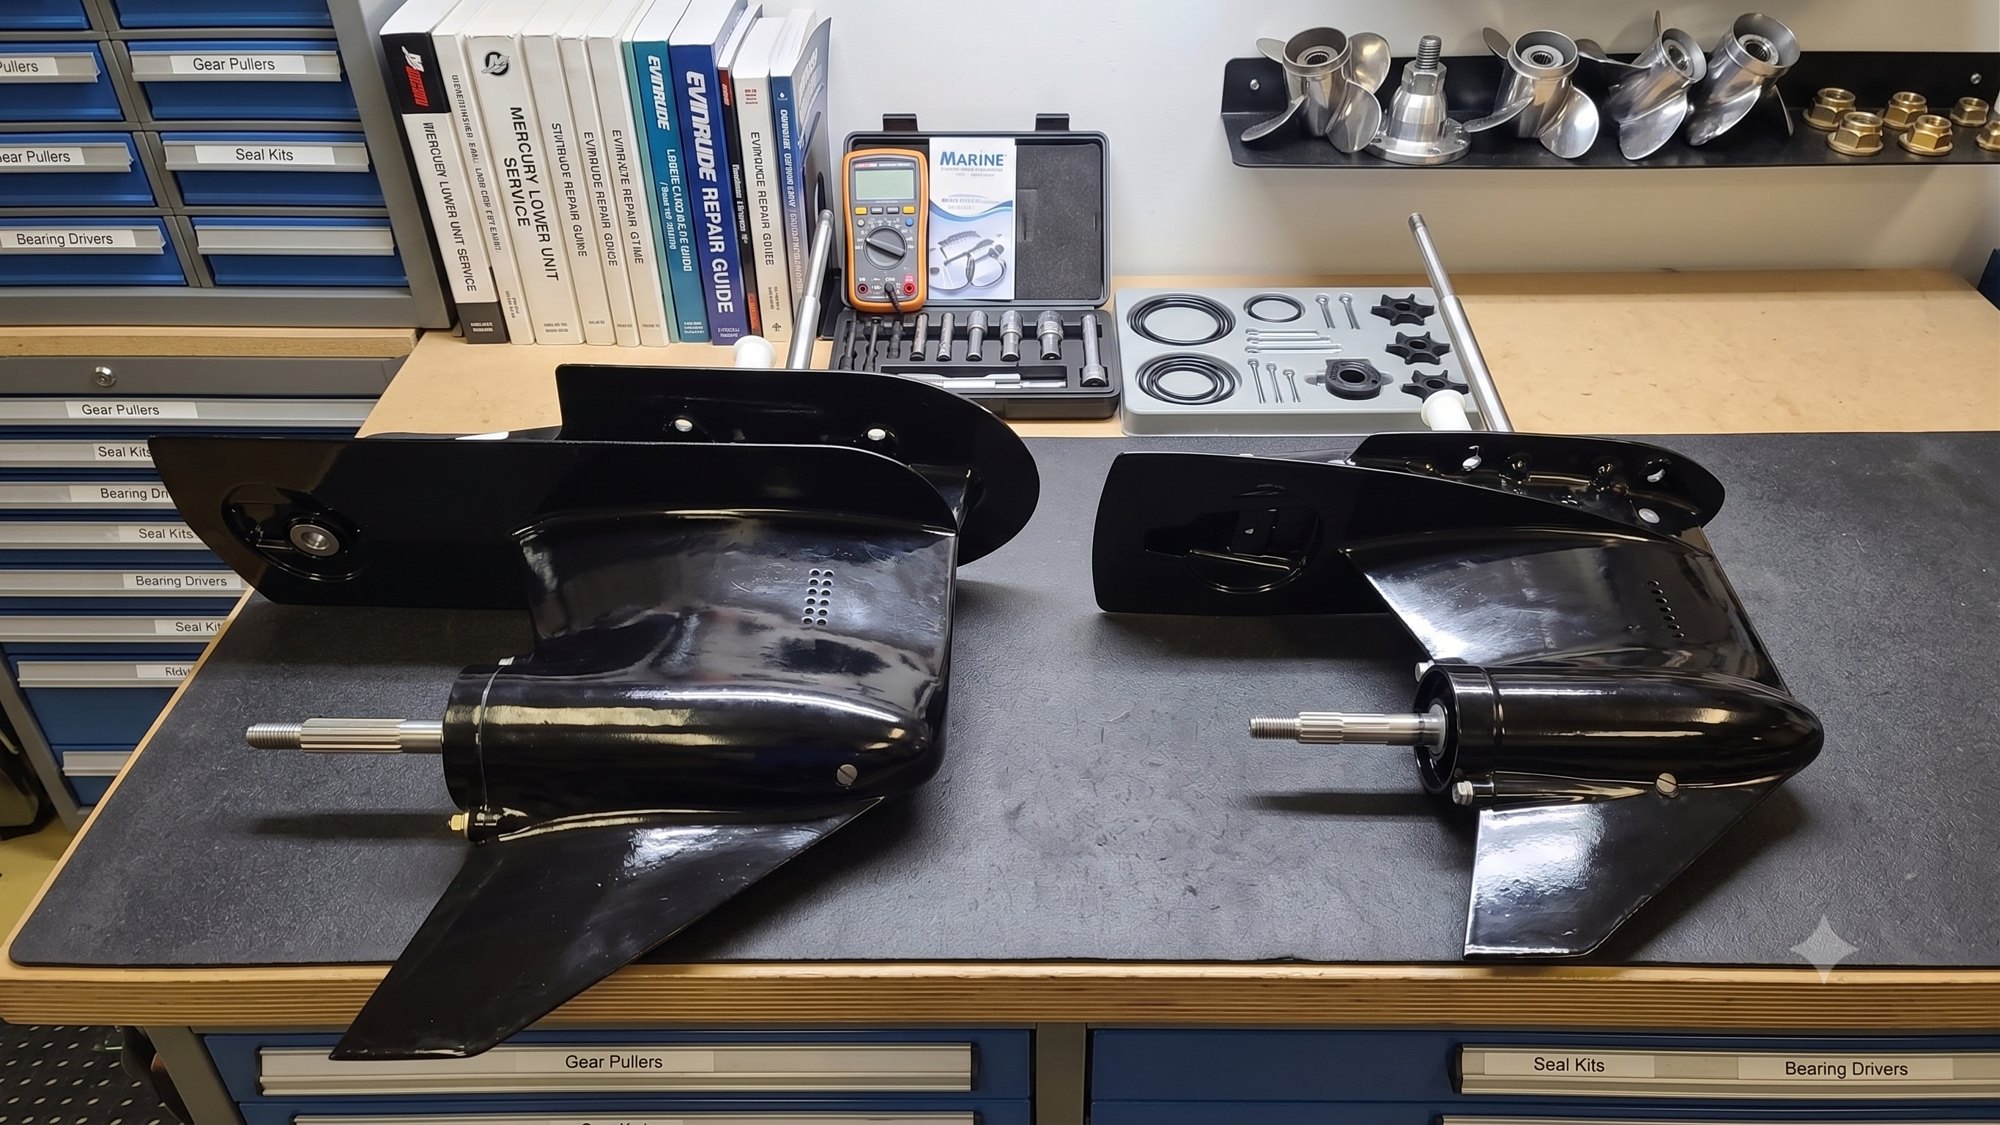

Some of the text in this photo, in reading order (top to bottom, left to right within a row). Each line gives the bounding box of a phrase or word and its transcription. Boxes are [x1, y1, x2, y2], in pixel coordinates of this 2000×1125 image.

[0, 60, 39, 73] ullers
[193, 57, 276, 71] Gear Pullers
[648, 55, 671, 131] EVINRUDE
[686, 70, 716, 183] EVINRUDE
[26, 150, 71, 163] Pullers
[235, 148, 294, 161] Seal Kits
[939, 151, 1004, 167] MARINE
[503, 157, 531, 227] SERVICE
[510, 107, 559, 281] MERCURY LOWER UNIT
[563, 181, 579, 221] REPAIR
[622, 188, 638, 227] REPAIR
[596, 192, 611, 229] REPAIR
[757, 190, 771, 229] REPAIR
[702, 187, 726, 253] REPAIR
[16, 232, 114, 248] Bearing Drivers
[451, 221, 465, 246] UNIT
[456, 248, 477, 292] SERVICE
[712, 259, 734, 314] GUIDE
[82, 404, 160, 415] Gear Pullers
[98, 446, 126, 457] Seal
[101, 488, 147, 501] Bearing
[138, 528, 194, 539] Seal Kits
[135, 575, 228, 588] Bearing Drivers
[175, 621, 222, 632] Seal Kit
[565, 1054, 663, 1069] Gear Pullers
[1533, 1056, 1605, 1072] Seal Kits
[1785, 1061, 1909, 1079] Bearing Drivers
